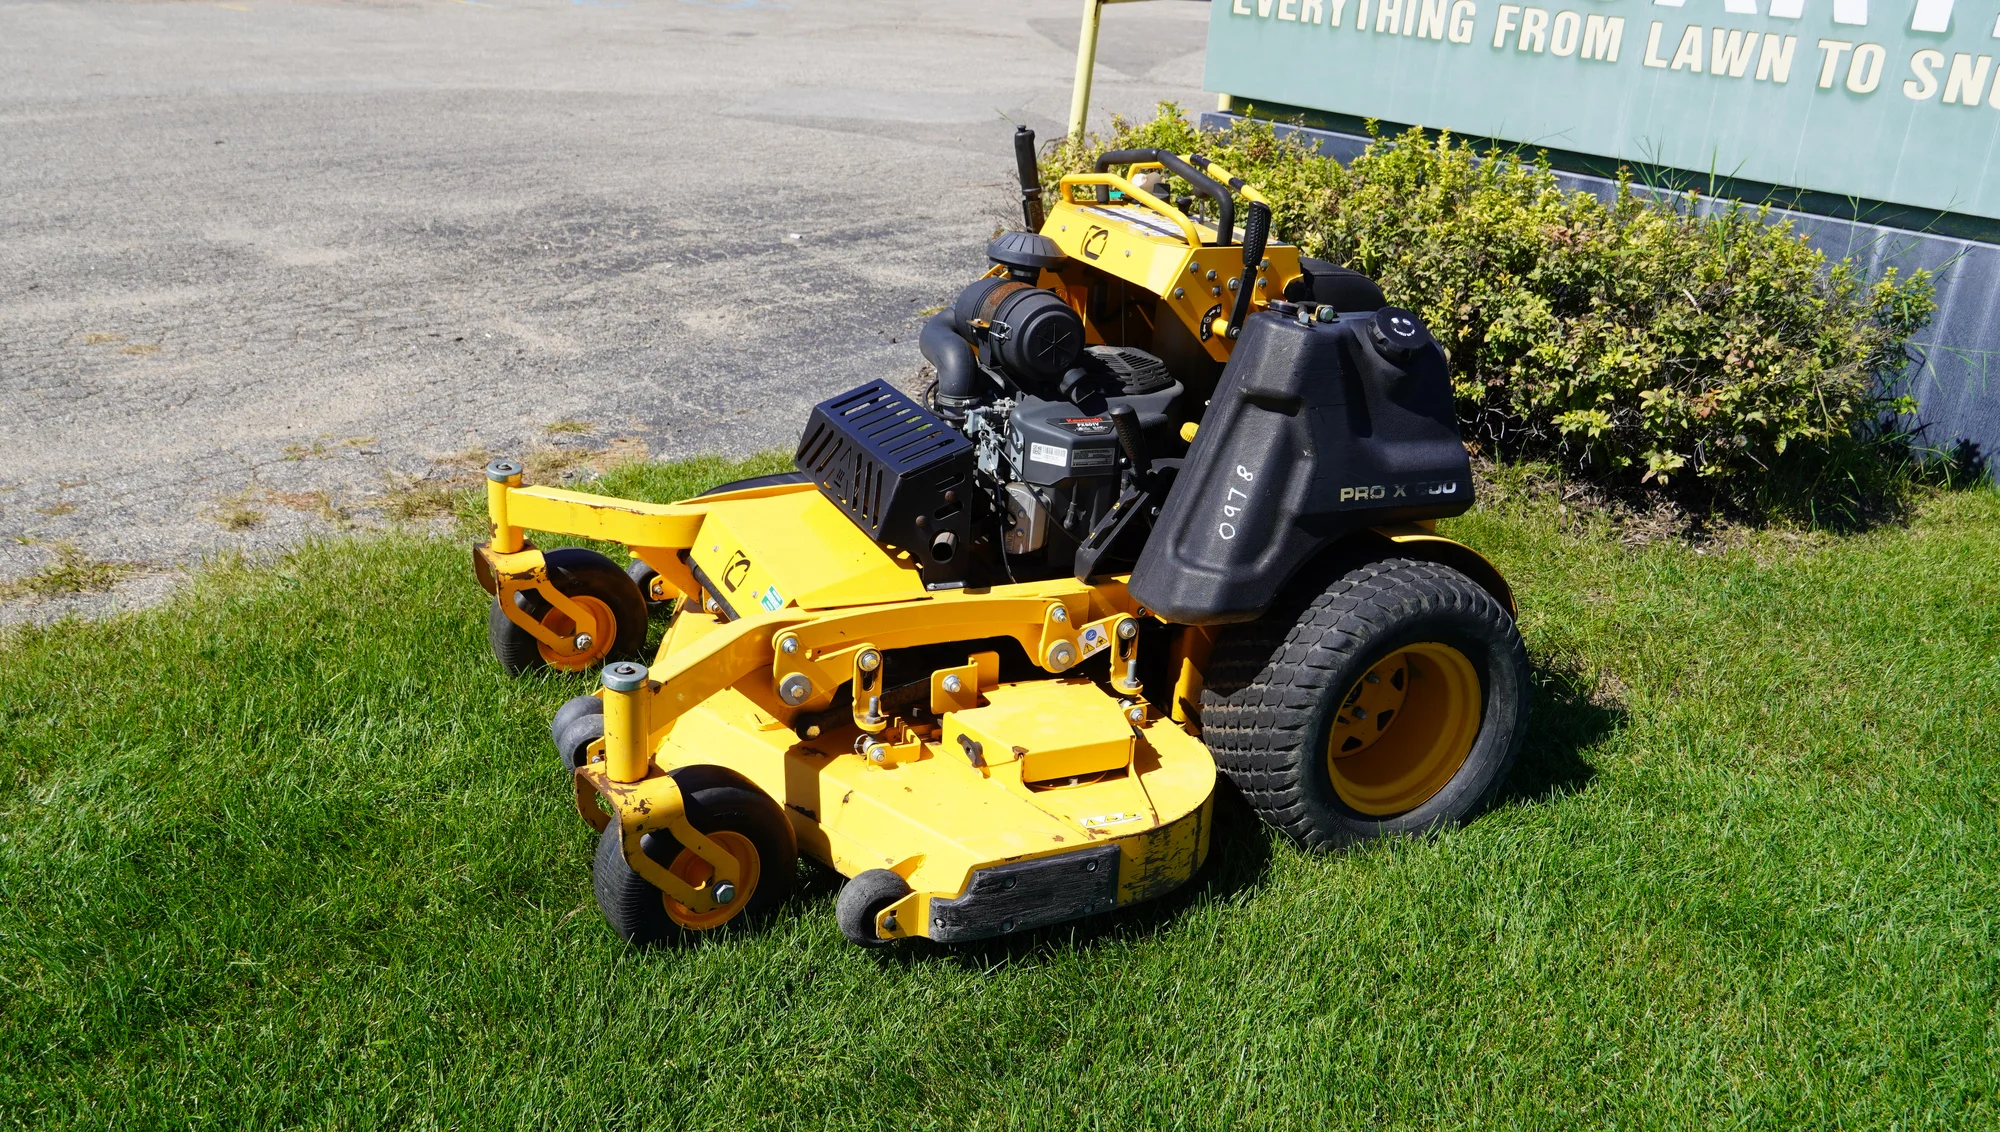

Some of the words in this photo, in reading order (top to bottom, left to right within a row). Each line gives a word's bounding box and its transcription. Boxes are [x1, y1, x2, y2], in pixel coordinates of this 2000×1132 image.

[1493, 4, 1625, 62] FROM
[1643, 21, 1797, 83] LAWN
[1817, 38, 1887, 94] TO
[1902, 49, 2000, 111] SN
[1219, 465, 1253, 539] 0978
[1340, 485, 1385, 502] PRO
[1393, 484, 1407, 498] X
